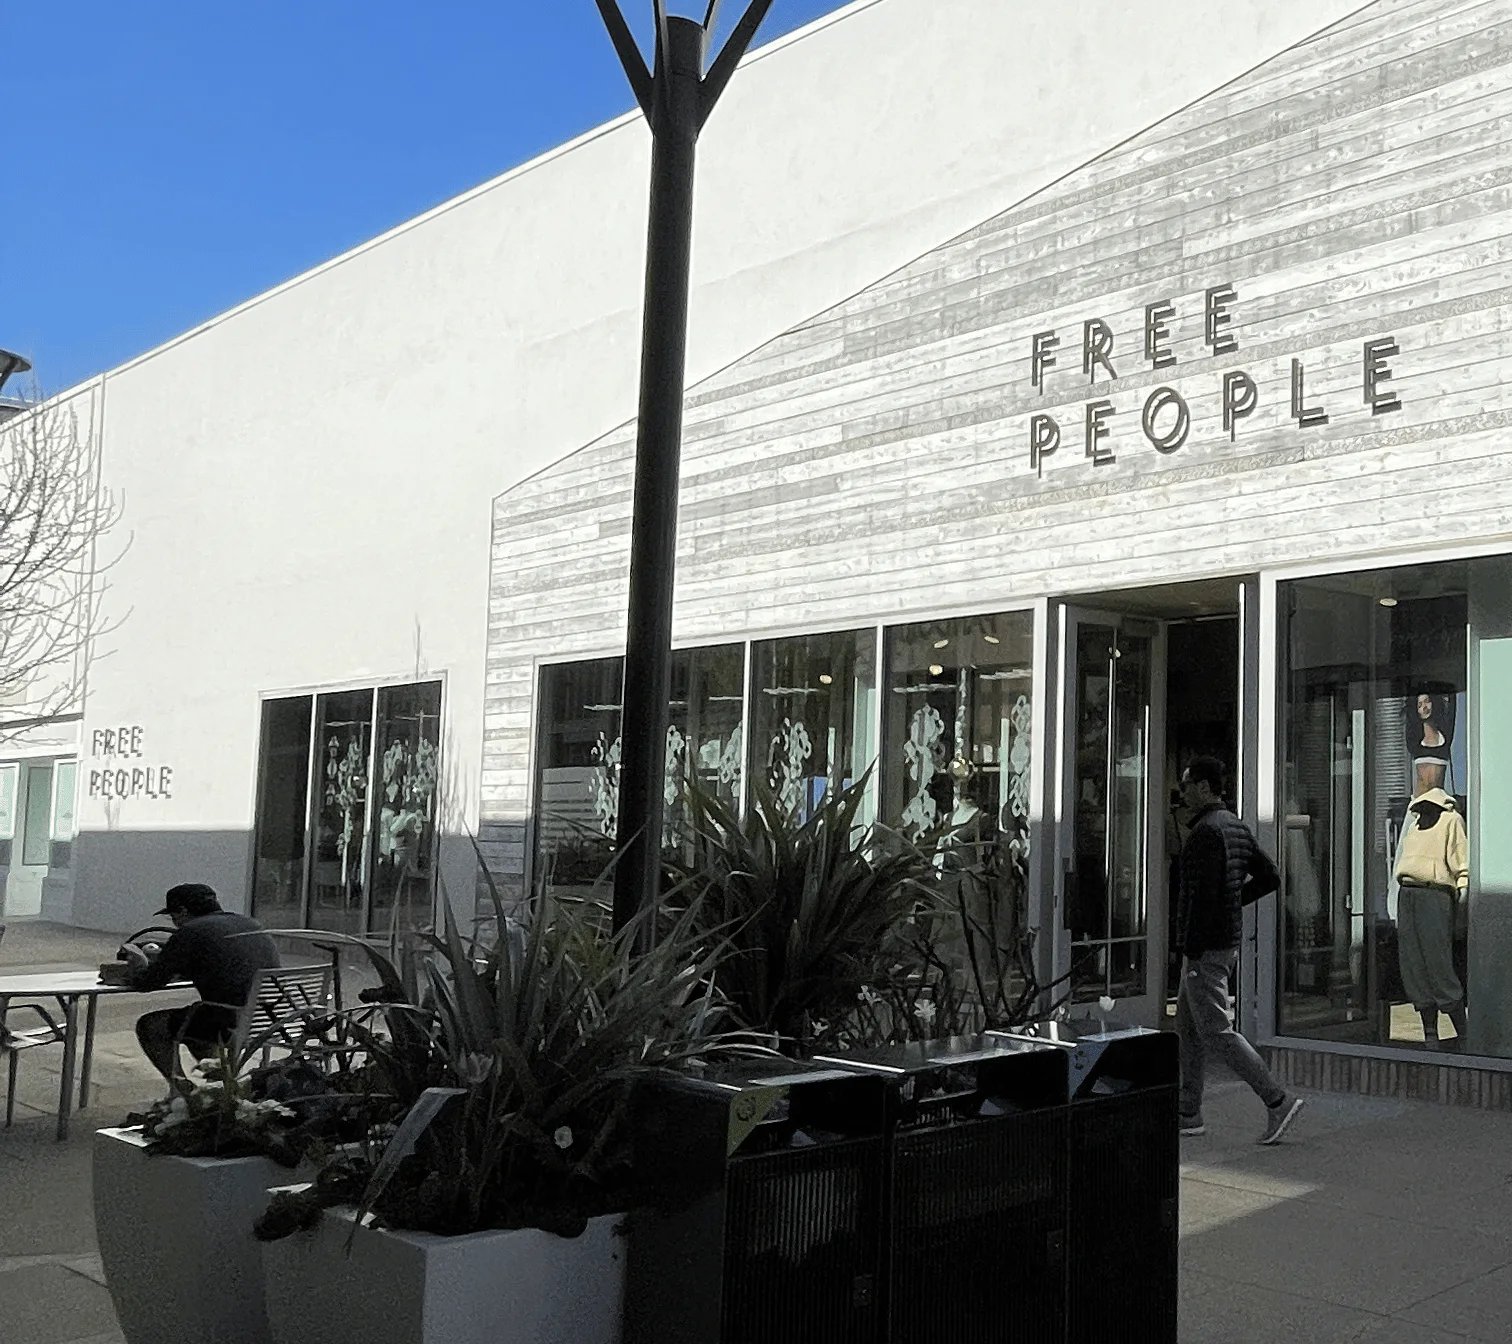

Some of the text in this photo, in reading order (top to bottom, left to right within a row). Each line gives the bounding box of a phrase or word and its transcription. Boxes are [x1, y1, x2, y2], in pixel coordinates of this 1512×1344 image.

[1031, 283, 1238, 394] FREE
[1030, 336, 1402, 477] PEOPLE
[92, 725, 144, 758] FREE
[89, 766, 173, 800] PEOPLE
